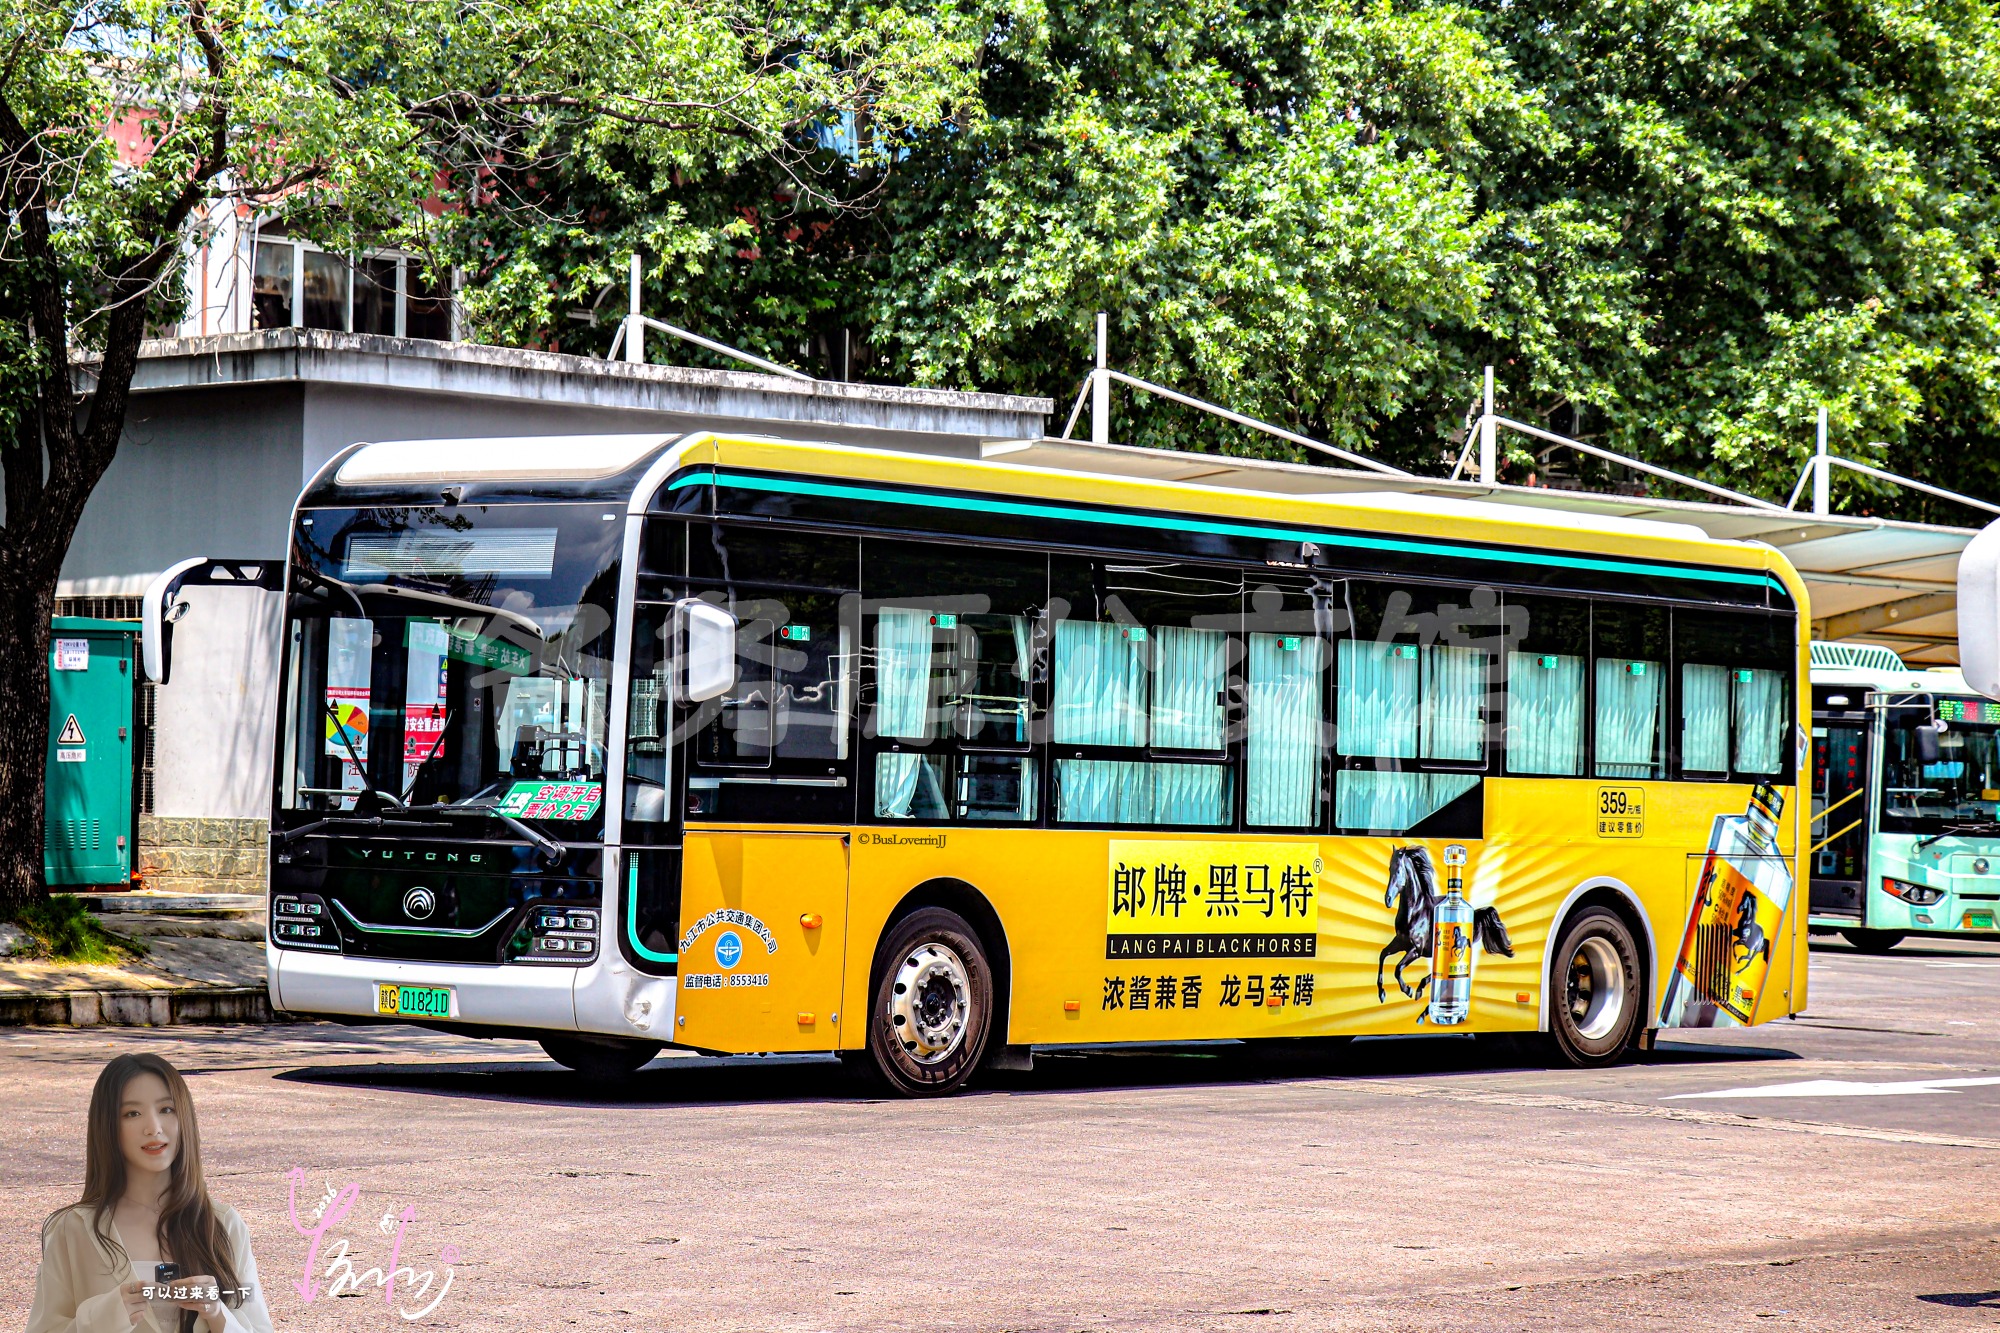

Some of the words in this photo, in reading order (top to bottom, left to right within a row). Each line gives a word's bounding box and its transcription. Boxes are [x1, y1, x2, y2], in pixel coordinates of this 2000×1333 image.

[535, 784, 602, 803] 空调开启
[521, 802, 591, 820] 票价2元
[1599, 821, 1642, 834] 建议零售价
[362, 849, 482, 863] YUTONG
[679, 907, 778, 955] 九江市公共交通集团公司
[1110, 939, 1156, 954] LANG
[1162, 939, 1190, 954] PAI
[1196, 938, 1251, 954] BLACK
[1257, 938, 1313, 953] HORSE
[1101, 974, 1203, 1011] 浓酱兼香
[1218, 972, 1315, 1008] 龙马奔腾
